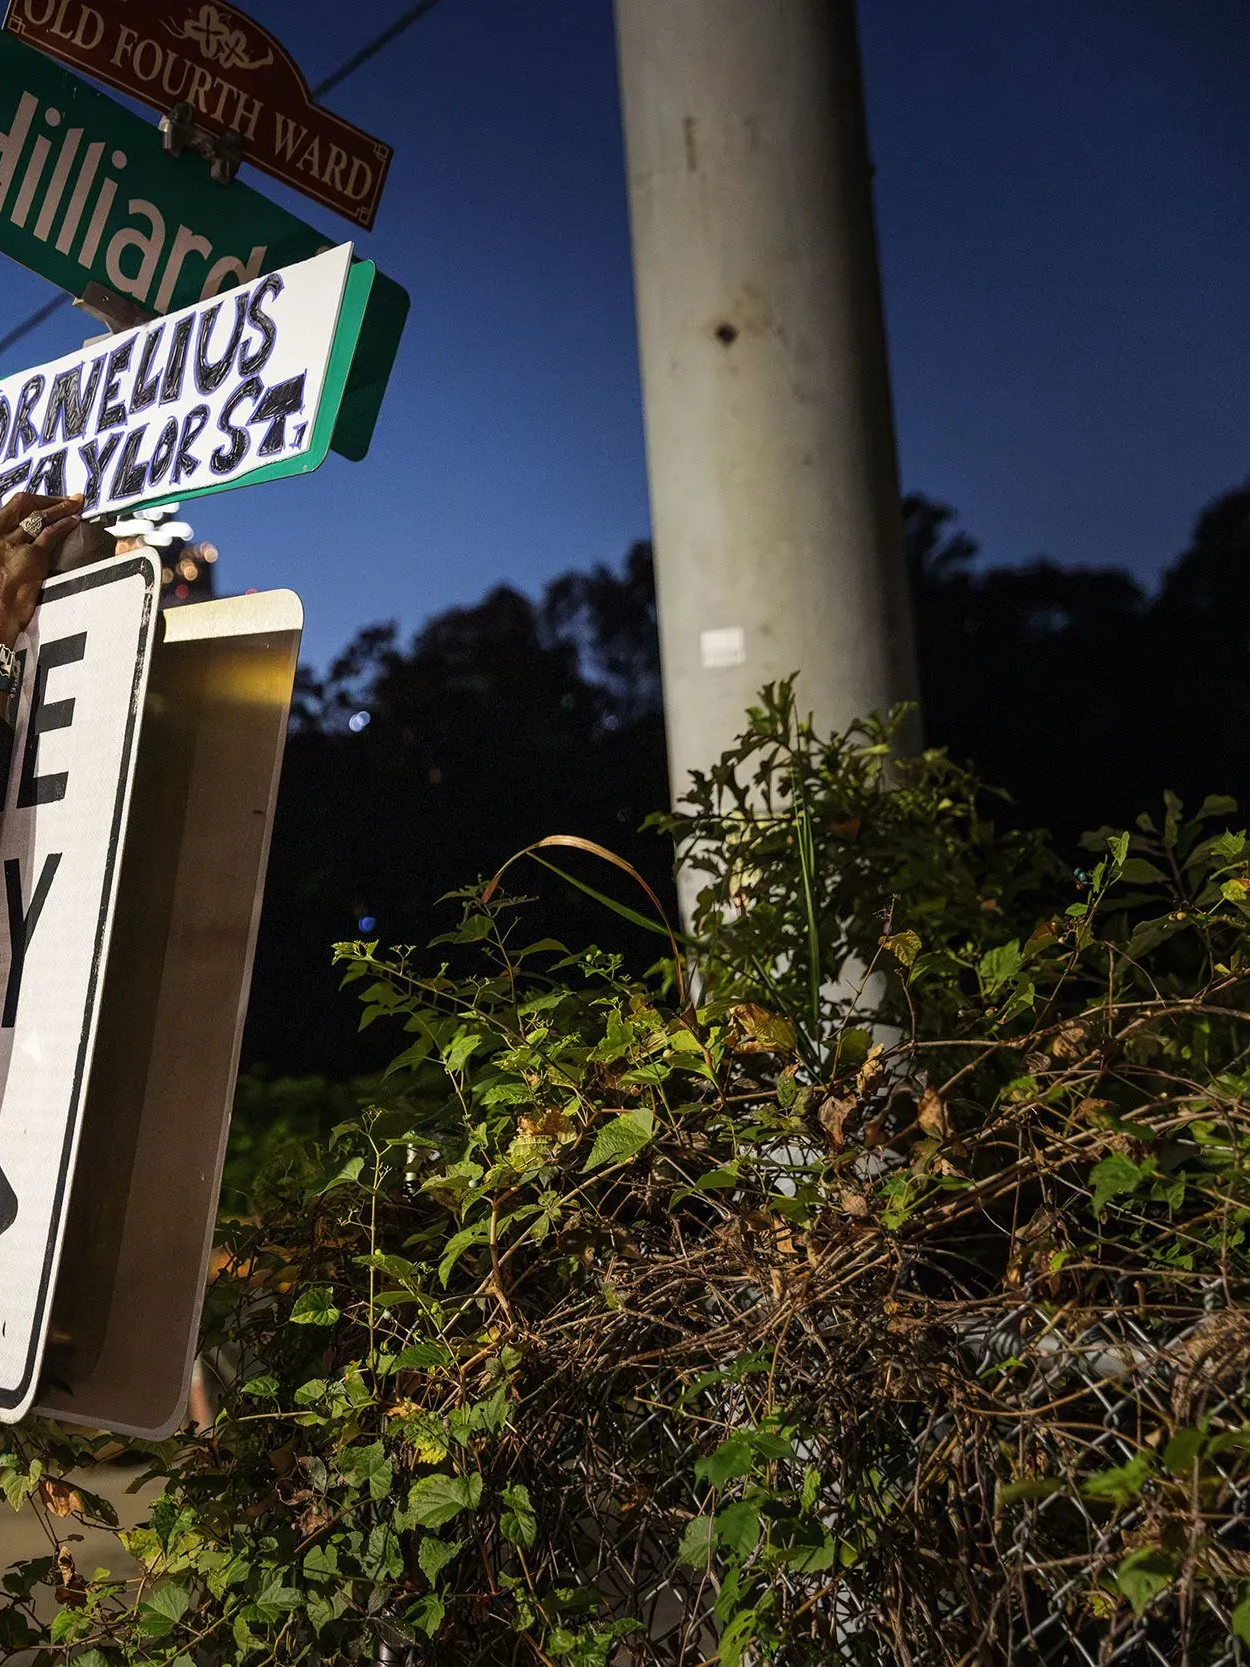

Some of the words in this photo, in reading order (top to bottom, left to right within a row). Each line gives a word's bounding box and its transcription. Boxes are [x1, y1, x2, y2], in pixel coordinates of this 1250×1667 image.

[23, 0, 105, 51] OLD
[110, 24, 264, 142] FOURTH
[272, 111, 373, 201] WARD
